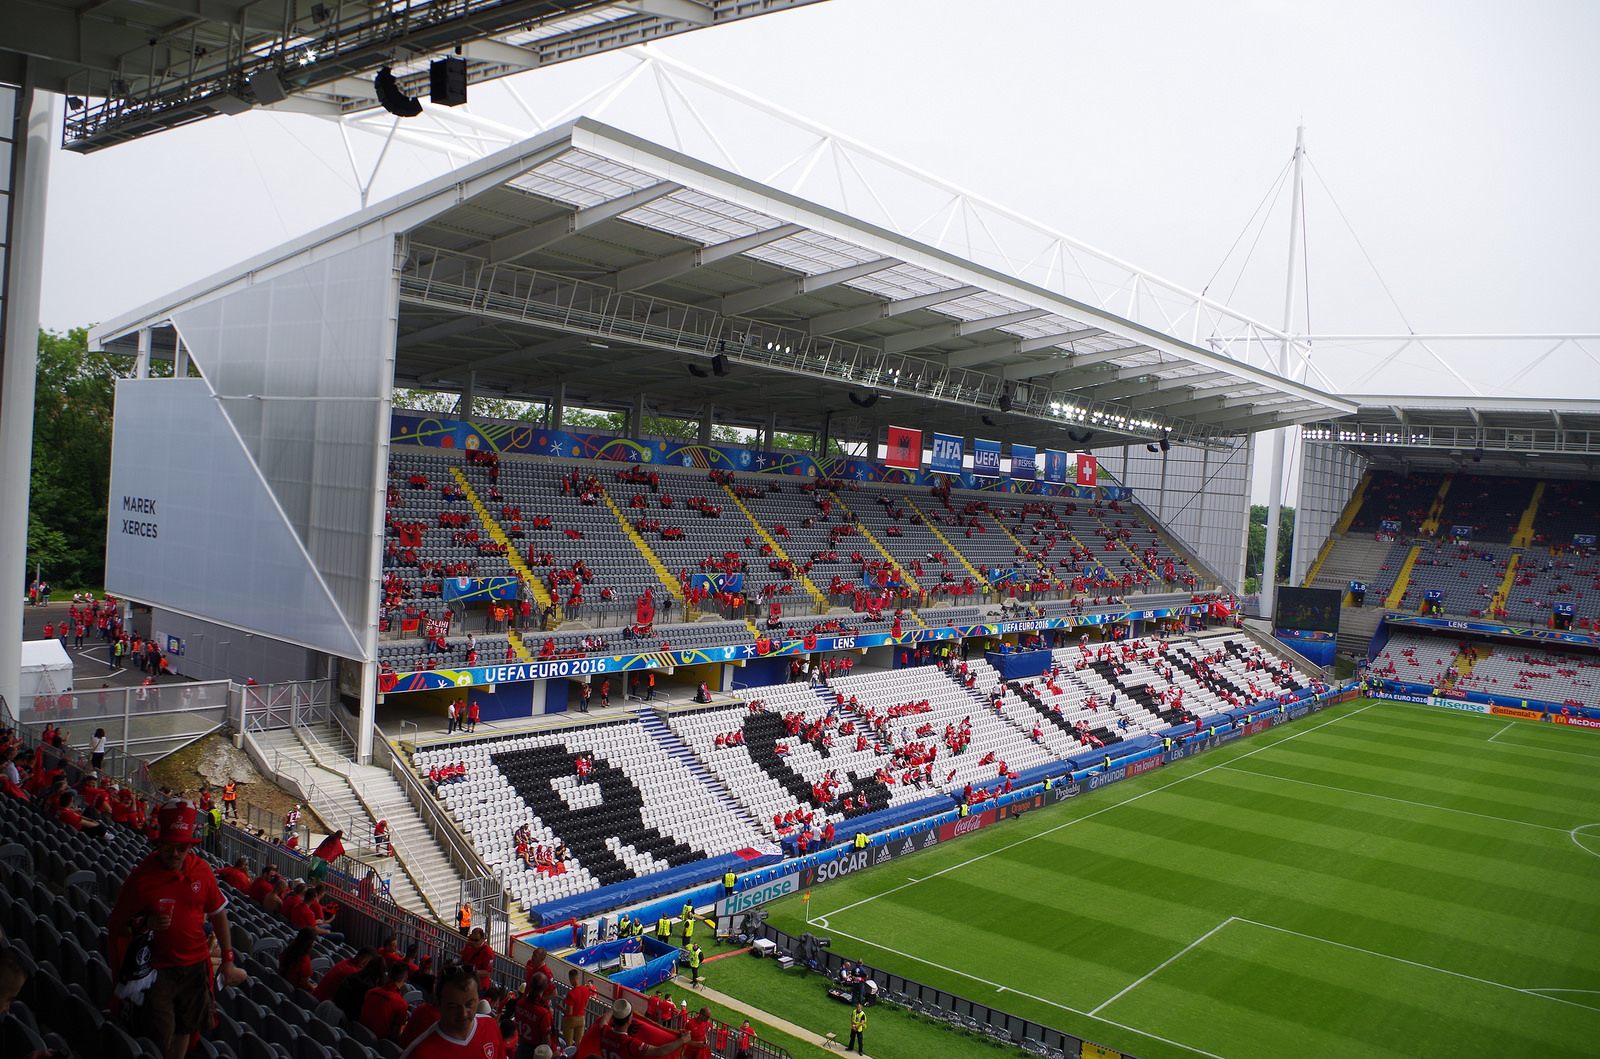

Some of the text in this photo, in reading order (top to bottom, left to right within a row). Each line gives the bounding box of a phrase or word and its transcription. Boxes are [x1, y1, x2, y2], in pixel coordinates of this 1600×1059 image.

[933, 439, 961, 460] FIFA
[975, 451, 1000, 466] UEFA
[123, 496, 156, 514] MAREK
[122, 520, 158, 538] XERCES
[1142, 610, 1154, 619] LENS
[1002, 620, 1049, 633] UEFA EURO 2016
[1448, 621, 1468, 629] LENS
[833, 638, 855, 649] LENS
[485, 659, 606, 682] UEFA EURO 2016
[1411, 696, 1428, 704] 2016
[1433, 697, 1485, 713] Hisense
[1171, 748, 1184, 761] LENS
[1099, 765, 1126, 785] HYUNDAI
[1055, 784, 1081, 800] Probably
[1011, 801, 1031, 813] Orange
[923, 838, 938, 848] adidas
[900, 845, 915, 856] adidas
[876, 854, 891, 864] adidas
[816, 851, 868, 883] SOCAR
[724, 880, 792, 916] Hisense
